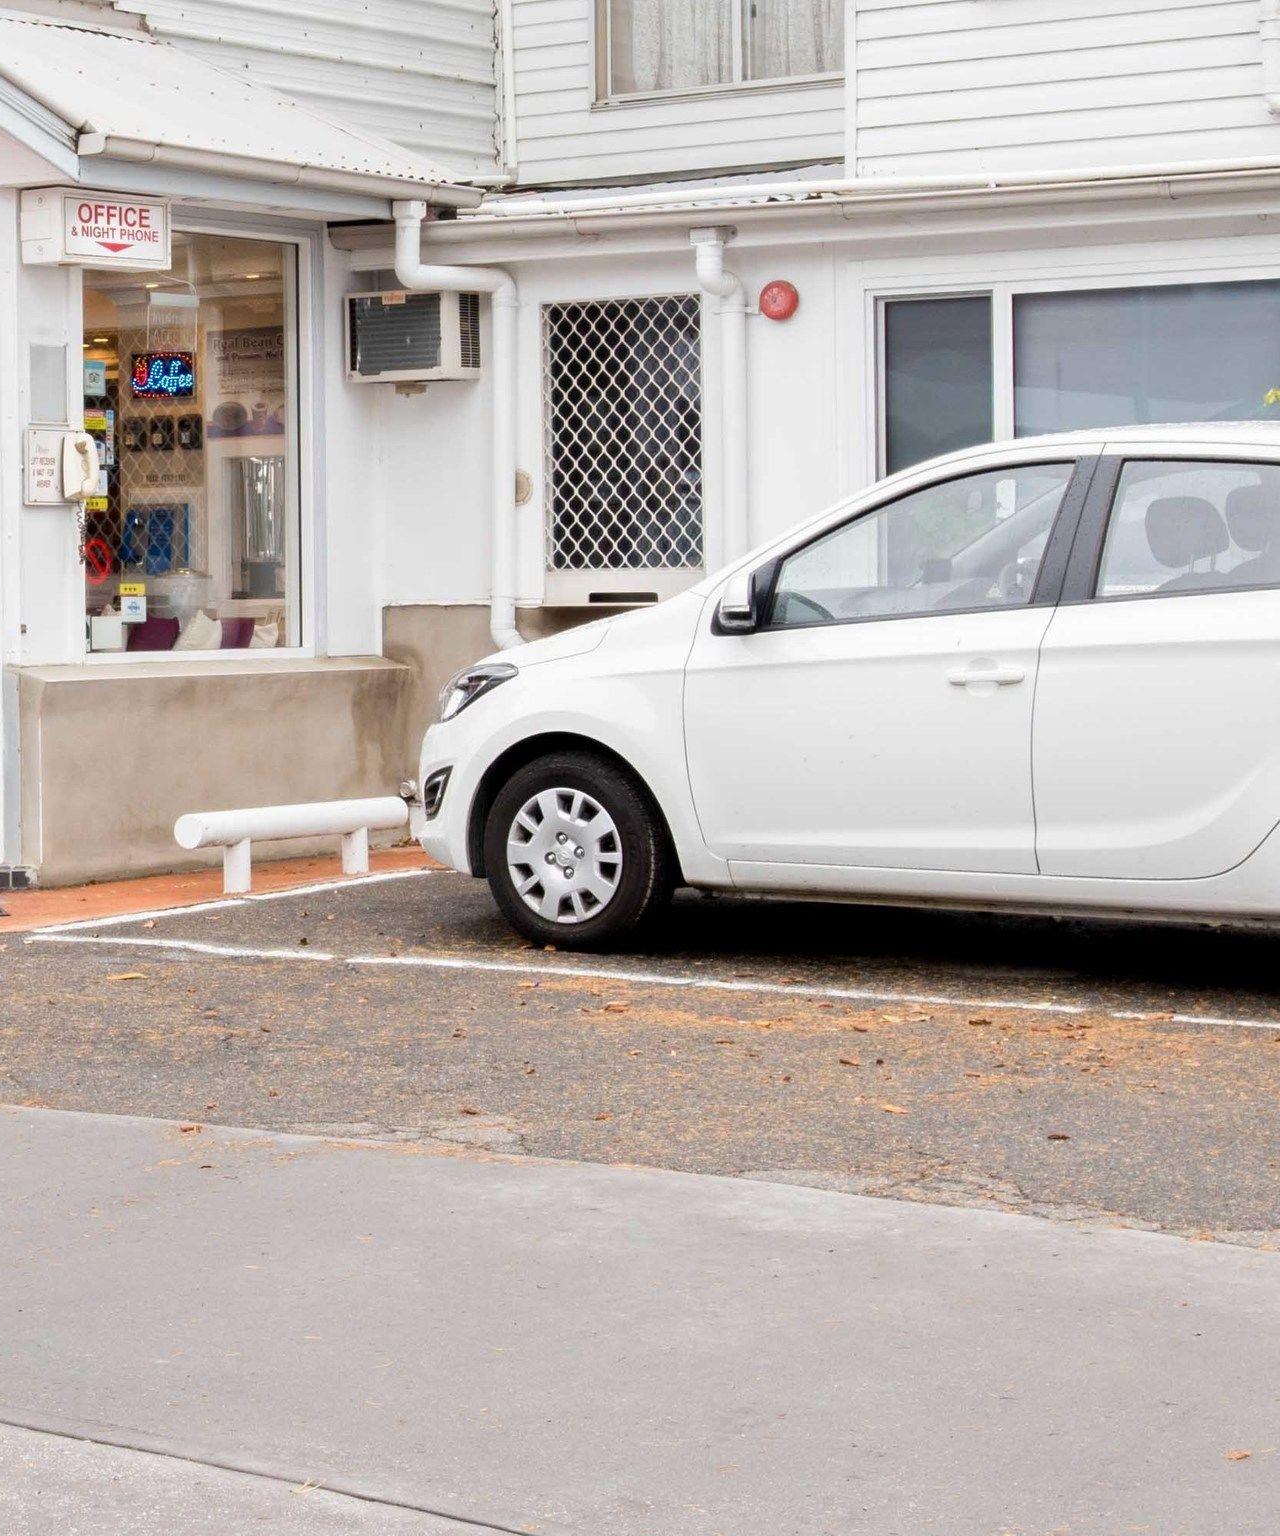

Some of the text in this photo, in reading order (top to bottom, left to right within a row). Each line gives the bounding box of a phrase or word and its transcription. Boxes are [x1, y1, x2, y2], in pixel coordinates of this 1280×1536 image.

[77, 203, 151, 229] OFFICE
[71, 225, 159, 243] & NIGHT PHONE
[147, 360, 194, 393] Coffee
